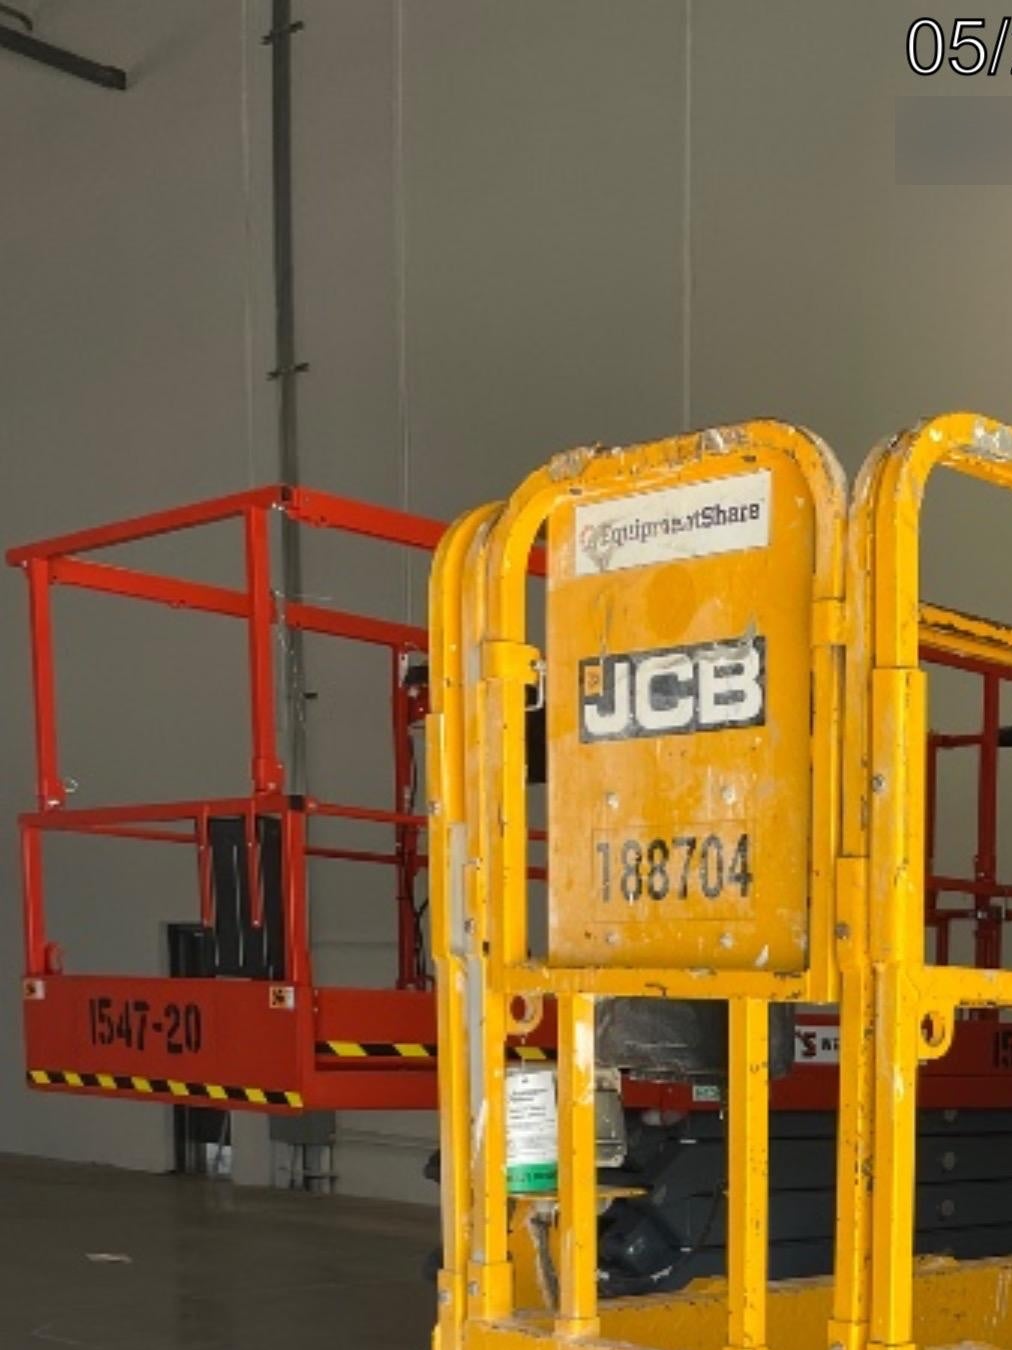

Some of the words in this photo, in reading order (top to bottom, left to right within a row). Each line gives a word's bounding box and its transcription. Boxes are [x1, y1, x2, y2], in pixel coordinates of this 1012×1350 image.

[584, 646, 763, 735] JCB
[596, 833, 753, 903] 188704
[89, 998, 202, 1054] 1547-20
